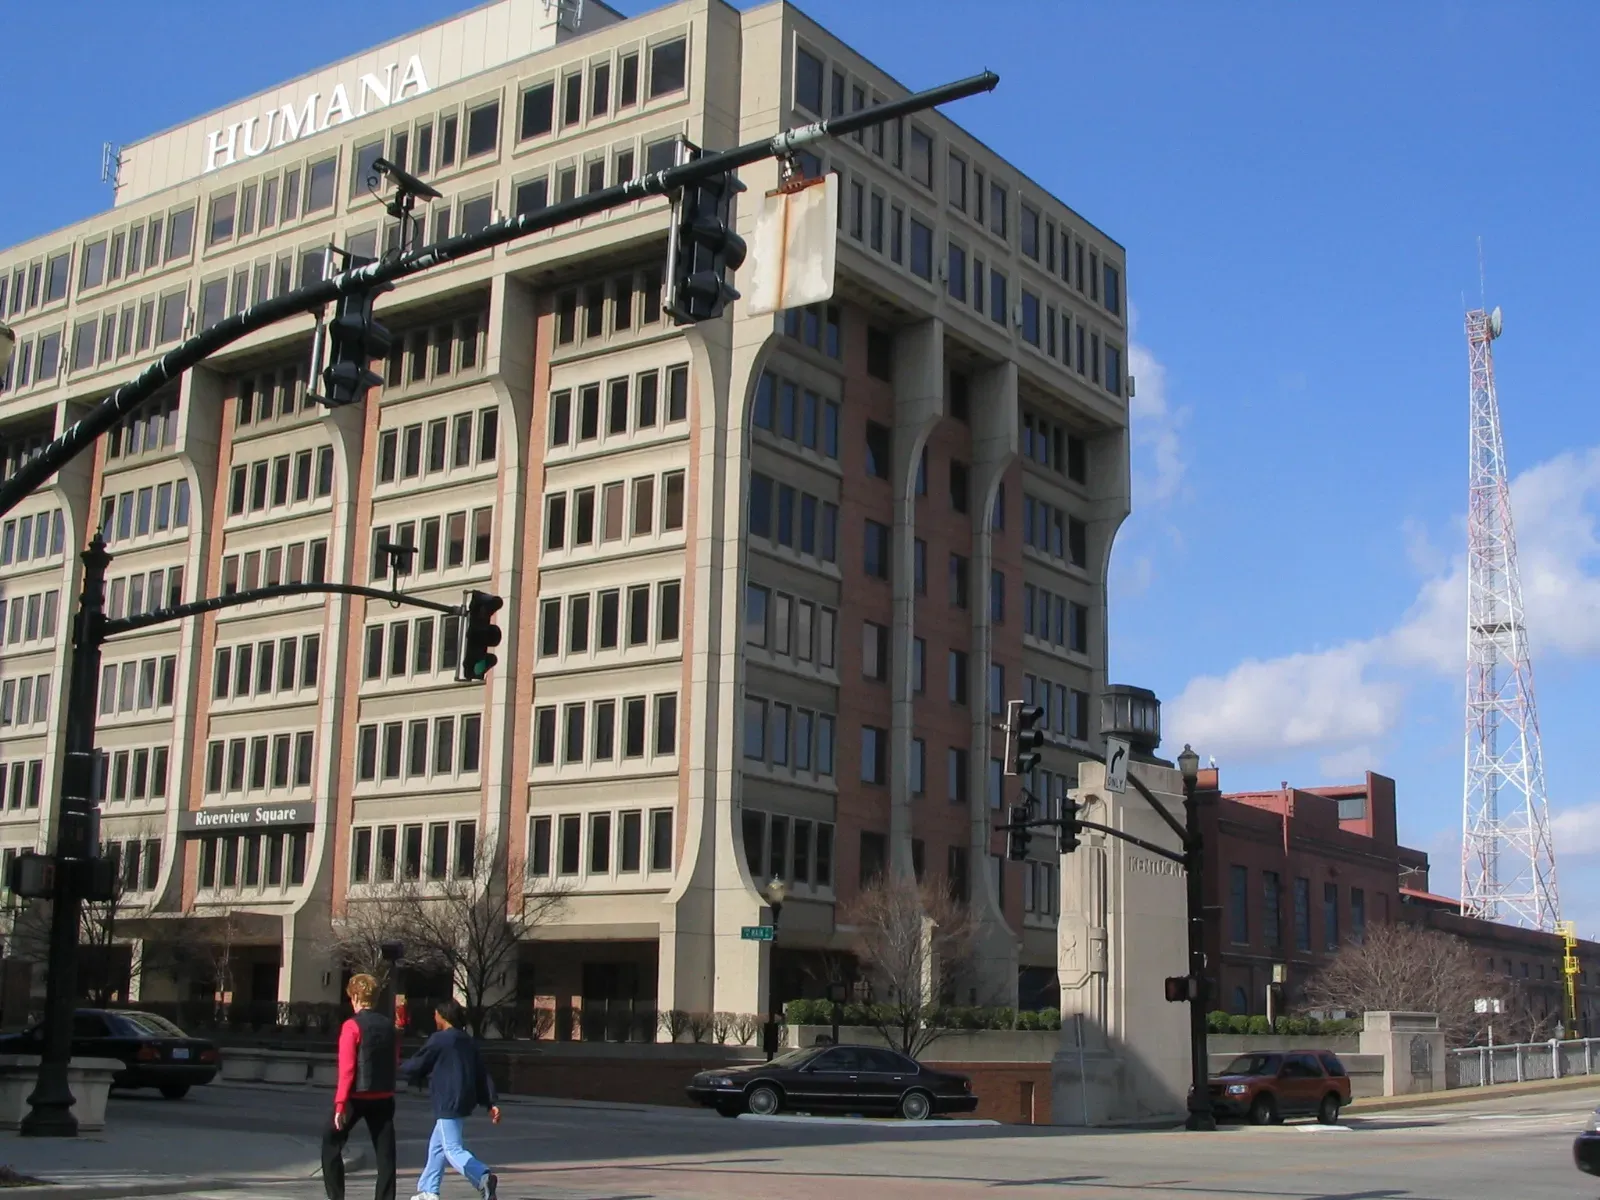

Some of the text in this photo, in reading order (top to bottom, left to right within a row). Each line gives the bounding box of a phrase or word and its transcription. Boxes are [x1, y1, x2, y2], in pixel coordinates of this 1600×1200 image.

[203, 53, 432, 173] HUMANA
[1107, 776, 1124, 789] ONLY
[195, 807, 296, 826] Riverview Square
